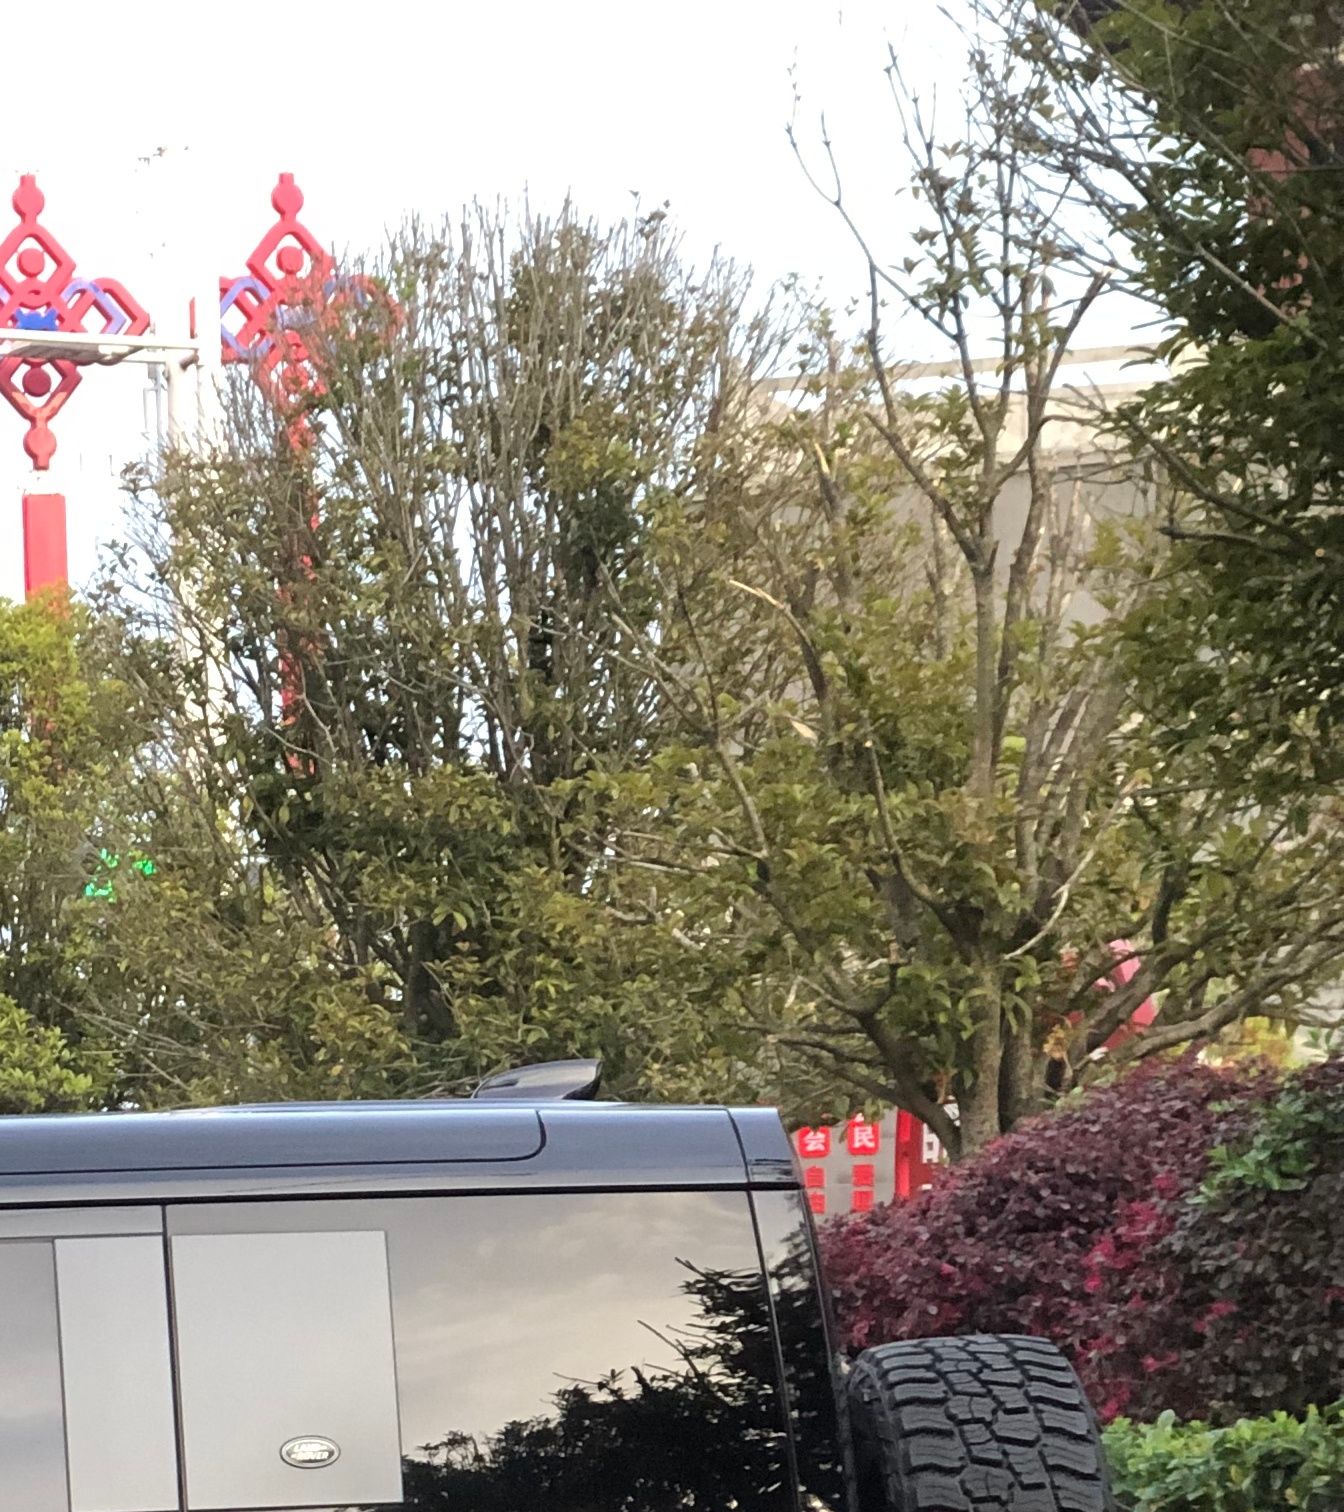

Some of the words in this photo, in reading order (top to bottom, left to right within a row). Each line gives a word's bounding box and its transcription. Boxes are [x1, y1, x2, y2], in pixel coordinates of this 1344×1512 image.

[803, 1129, 827, 1151] 会
[853, 1126, 876, 1148] 民
[296, 1451, 330, 1461] ROVER
